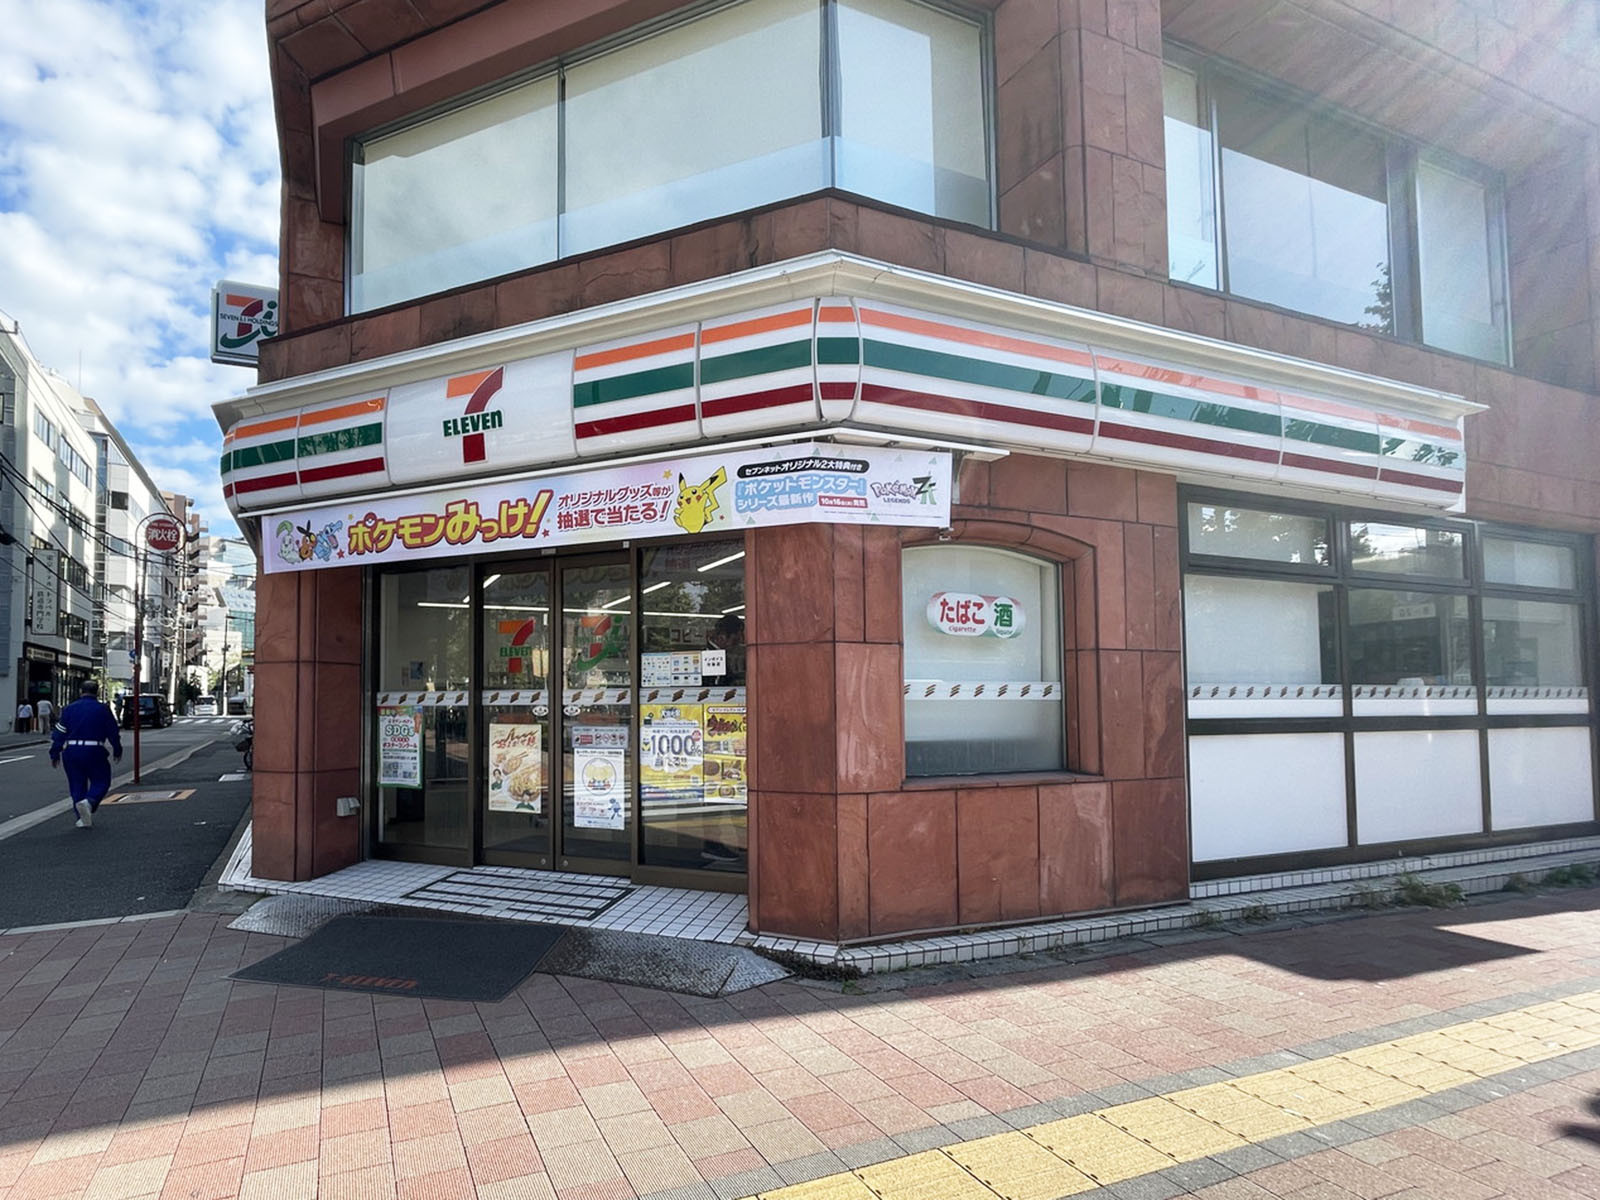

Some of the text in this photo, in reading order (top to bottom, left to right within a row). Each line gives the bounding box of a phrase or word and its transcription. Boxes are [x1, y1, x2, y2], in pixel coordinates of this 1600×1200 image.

[446, 365, 505, 464] 7
[558, 483, 673, 508] オリジナルグッズ等が
[147, 528, 177, 542] 消火栓
[940, 598, 1013, 628] たばこ 酒
[385, 724, 416, 737] SDGs
